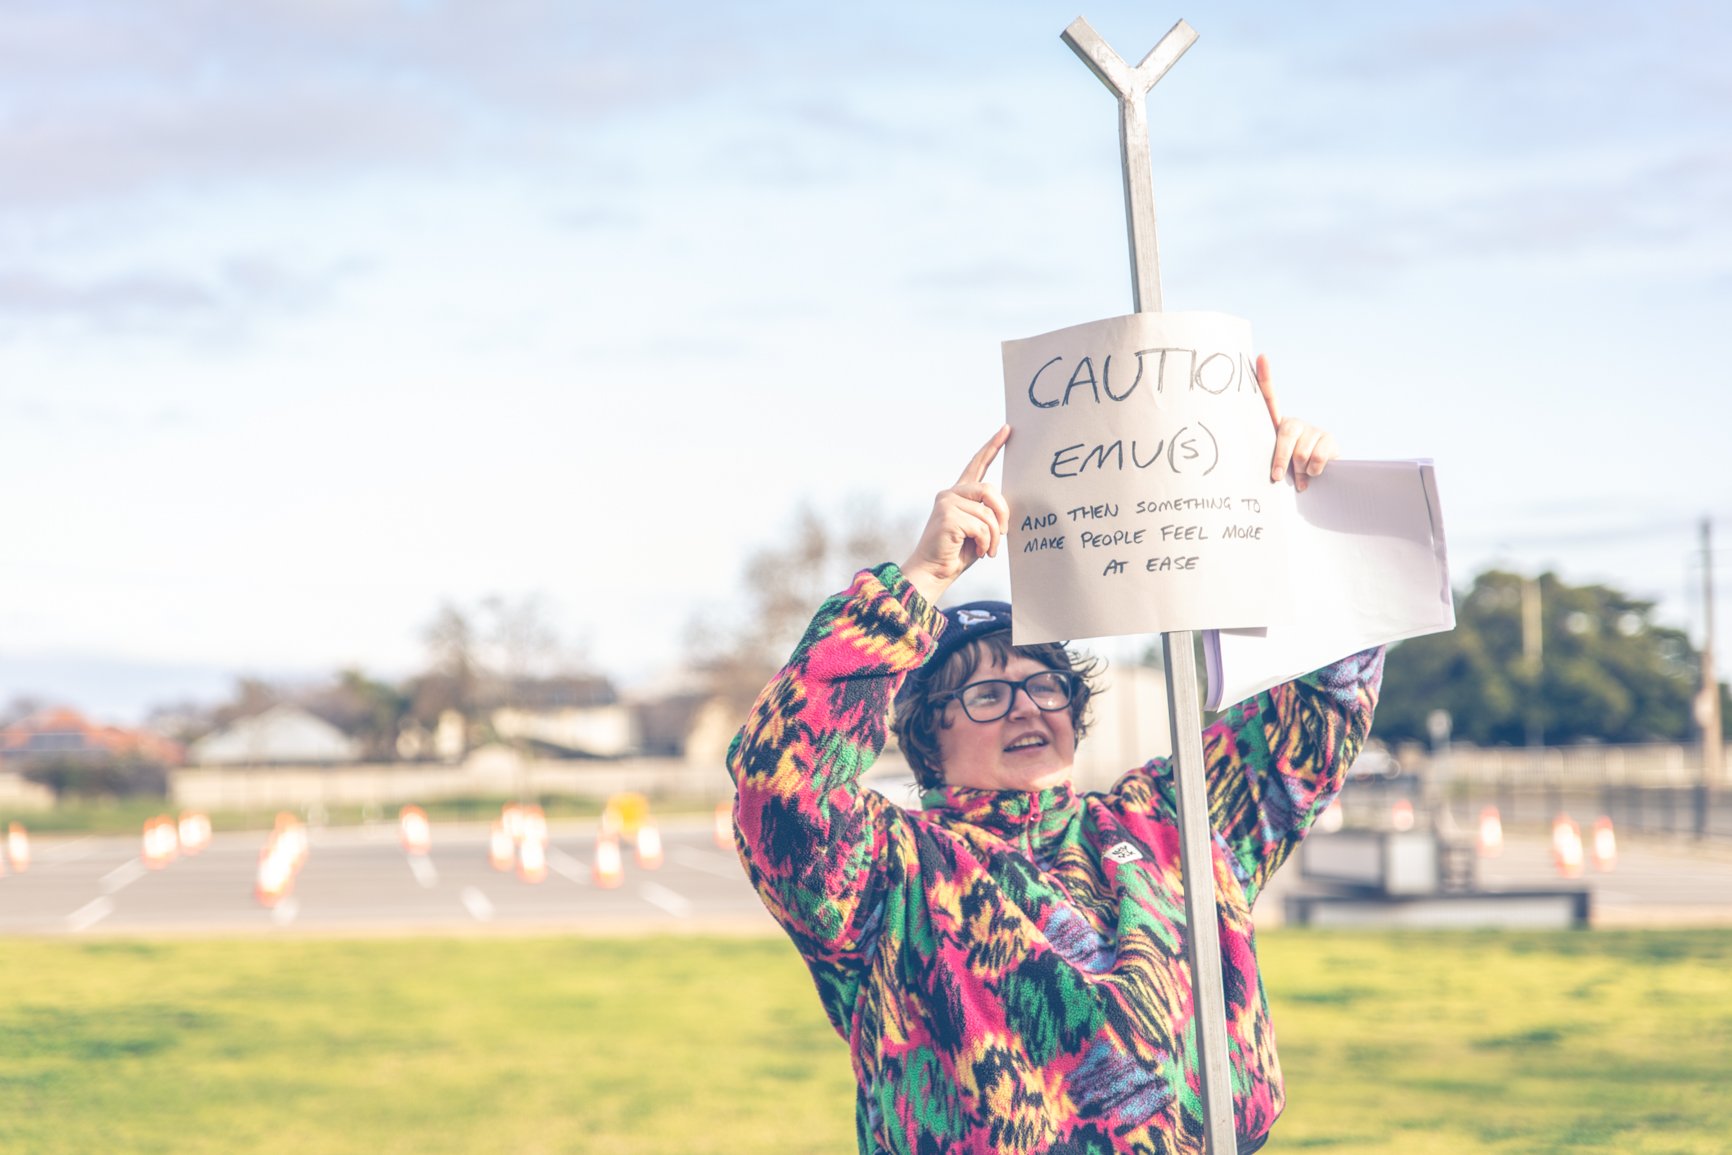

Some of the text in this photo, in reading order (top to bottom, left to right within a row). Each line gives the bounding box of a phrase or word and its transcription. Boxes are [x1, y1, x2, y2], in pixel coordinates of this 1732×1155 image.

[1028, 347, 1257, 408] CAUTION
[1051, 422, 1219, 477] EMU(S)
[1021, 496, 1261, 531] AND THEN SOMETHING TO
[1023, 525, 1263, 553] MAKE PEOPLE FEEL MORE
[1102, 556, 1199, 577] AT EASE
